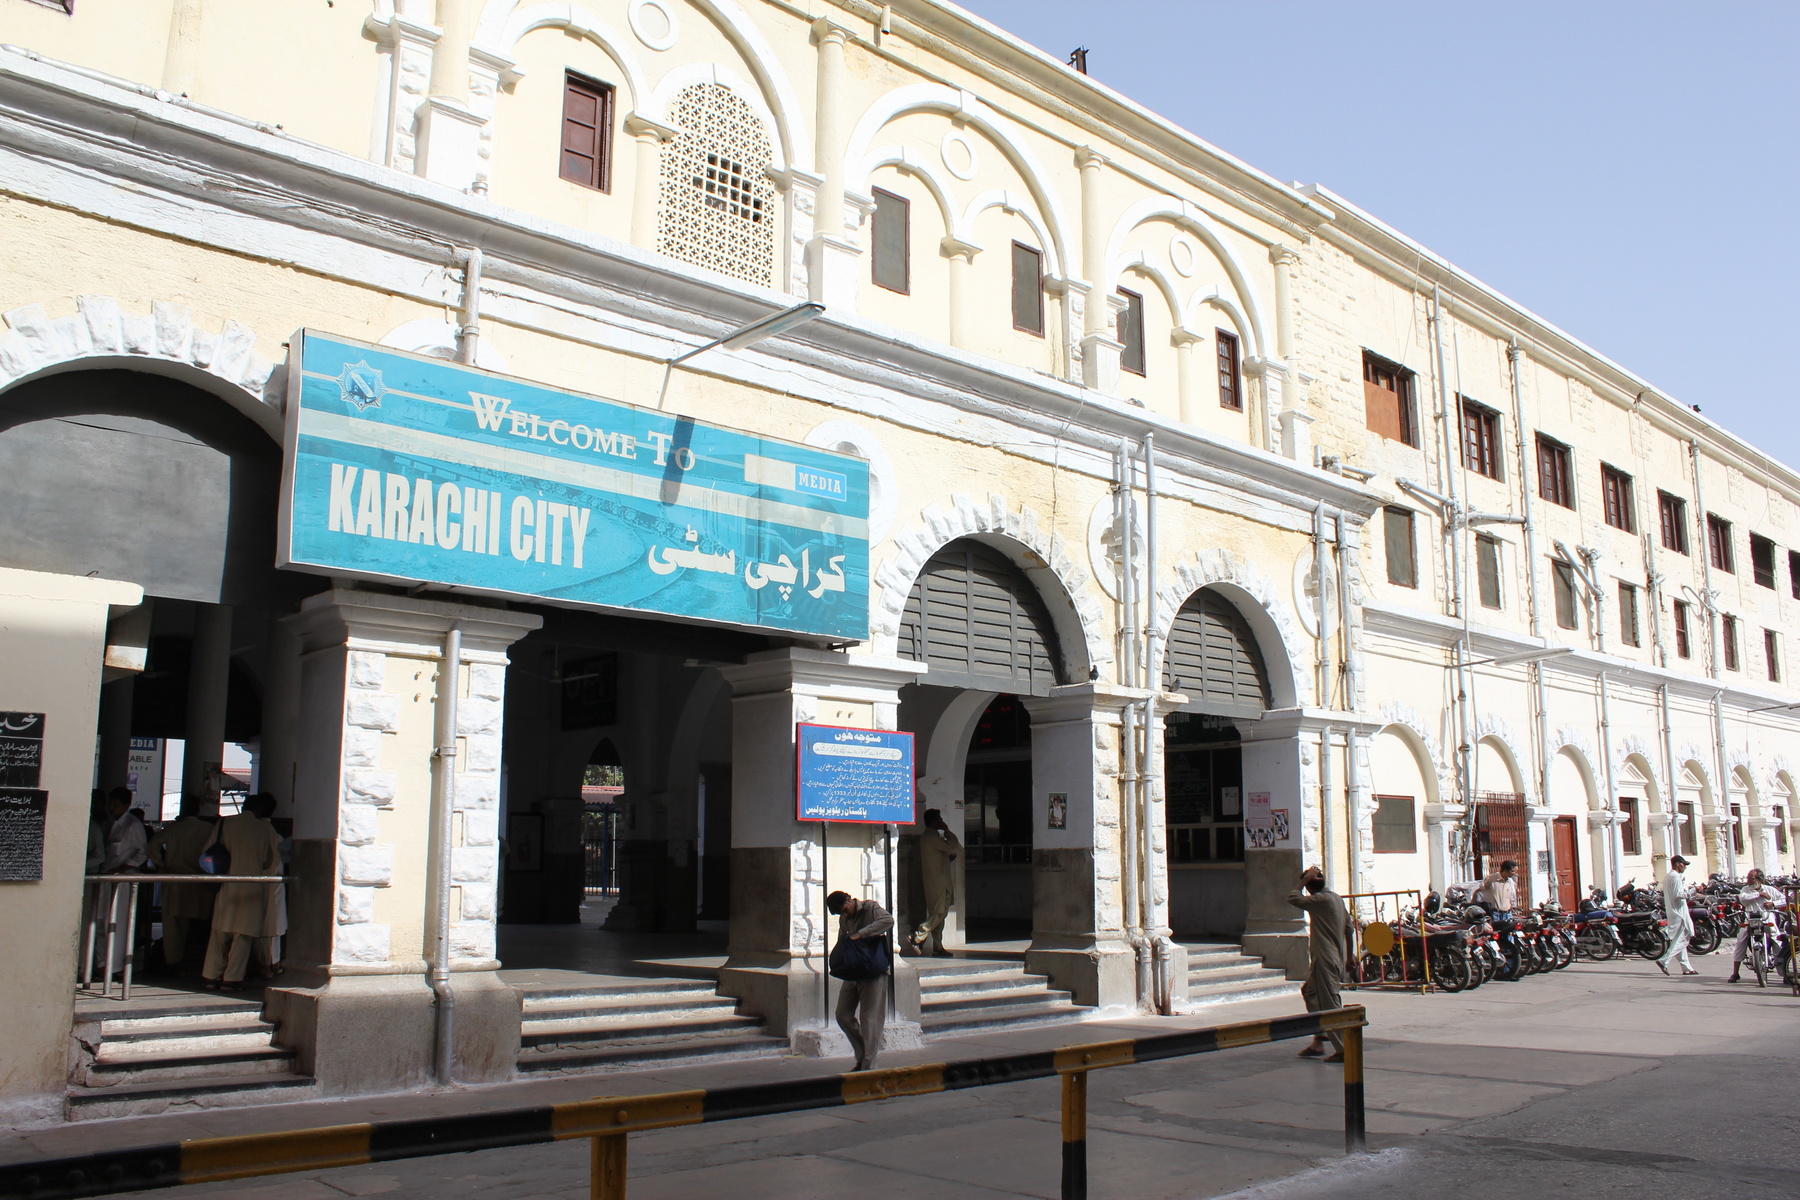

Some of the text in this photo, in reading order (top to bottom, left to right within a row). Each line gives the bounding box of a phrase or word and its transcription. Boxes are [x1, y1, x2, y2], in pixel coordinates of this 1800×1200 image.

[798, 471, 842, 494] MEDIA
[328, 464, 590, 569] KARACHI CITY
[648, 522, 847, 616] کراچی سٹی
[130, 739, 154, 748] EDIA
